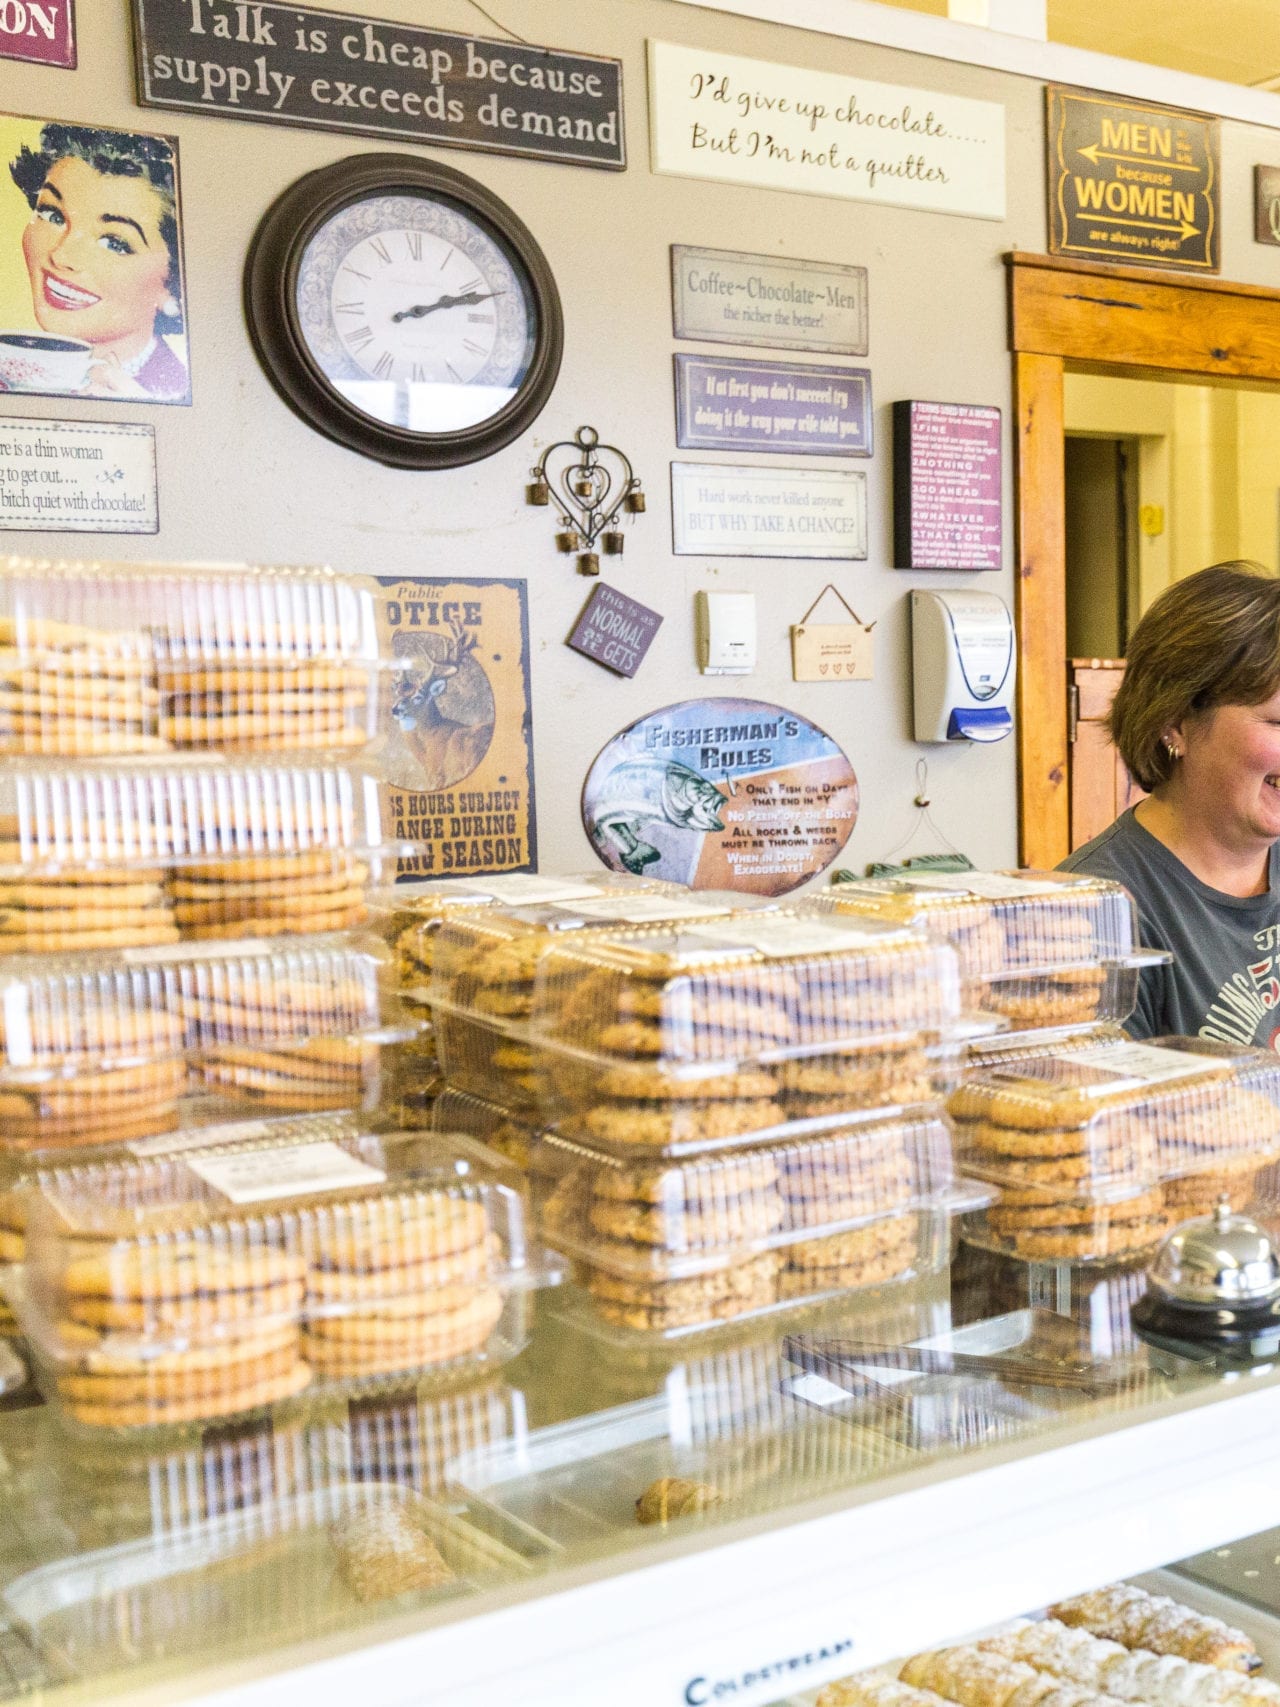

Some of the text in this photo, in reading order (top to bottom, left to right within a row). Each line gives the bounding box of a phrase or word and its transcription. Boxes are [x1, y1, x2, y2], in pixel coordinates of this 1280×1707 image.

[0, 0, 58, 40] ON
[189, 0, 604, 98] Talk is cheap because
[152, 52, 618, 146] supply exceeds demand
[690, 73, 732, 104] I'd
[737, 90, 791, 118] give
[796, 101, 831, 132] up
[1101, 118, 1171, 158] MEN
[690, 121, 951, 189] But I'm not a quitter
[1115, 164, 1173, 186] because
[1073, 176, 1196, 223] WOMEN
[1089, 229, 1109, 241] are
[1109, 231, 1150, 248] always
[723, 303, 825, 329] the richer the better!
[706, 376, 717, 396] If
[716, 379, 727, 396] at
[728, 377, 749, 398] first
[750, 384, 769, 403] you
[770, 381, 795, 401] don't
[796, 385, 832, 404] succeed
[694, 405, 724, 432] doing
[724, 407, 734, 428] it
[734, 408, 750, 428] the
[751, 415, 773, 435] way
[773, 416, 797, 435] your
[798, 413, 819, 434] wife
[819, 415, 839, 434] told
[13, 438, 23, 456] is
[25, 445, 32, 457] a
[34, 438, 58, 459] thin
[59, 446, 104, 461] woman
[7, 469, 19, 482] to
[21, 469, 39, 487] get
[1, 487, 146, 513] bitch quiet with chocolate!
[698, 487, 845, 510] Hard work never killed anyone
[939, 486, 979, 497] AHEAD
[688, 512, 856, 534] BUT WHY TAKE A CHANCE?
[964, 532, 981, 542] OK
[396, 587, 444, 600] Public
[386, 601, 483, 626] OTICE
[589, 604, 645, 651] NORMAL
[603, 640, 637, 671] GETS
[645, 715, 800, 749] FISHERMAN'S
[699, 746, 773, 770] RULES
[745, 783, 773, 795] ONLY
[778, 783, 801, 793] FISH
[805, 784, 819, 793] ON
[752, 797, 777, 806] THAT
[781, 796, 800, 806] END
[803, 796, 814, 805] IN
[408, 792, 455, 817] HOURS
[459, 790, 521, 815] SUBJECT
[727, 810, 745, 822] NO
[825, 808, 852, 820] BOAT
[396, 814, 517, 841] ANGE DURING
[732, 825, 838, 837] ALL ROCKS & WEEDS
[441, 838, 522, 869] SEASON
[721, 837, 837, 849] MUST BE THROWN BACK
[727, 851, 760, 864] WHEN
[762, 852, 773, 863] IN
[733, 861, 804, 876] EXAGGERATE!
[1198, 972, 1268, 1046] OLLING
